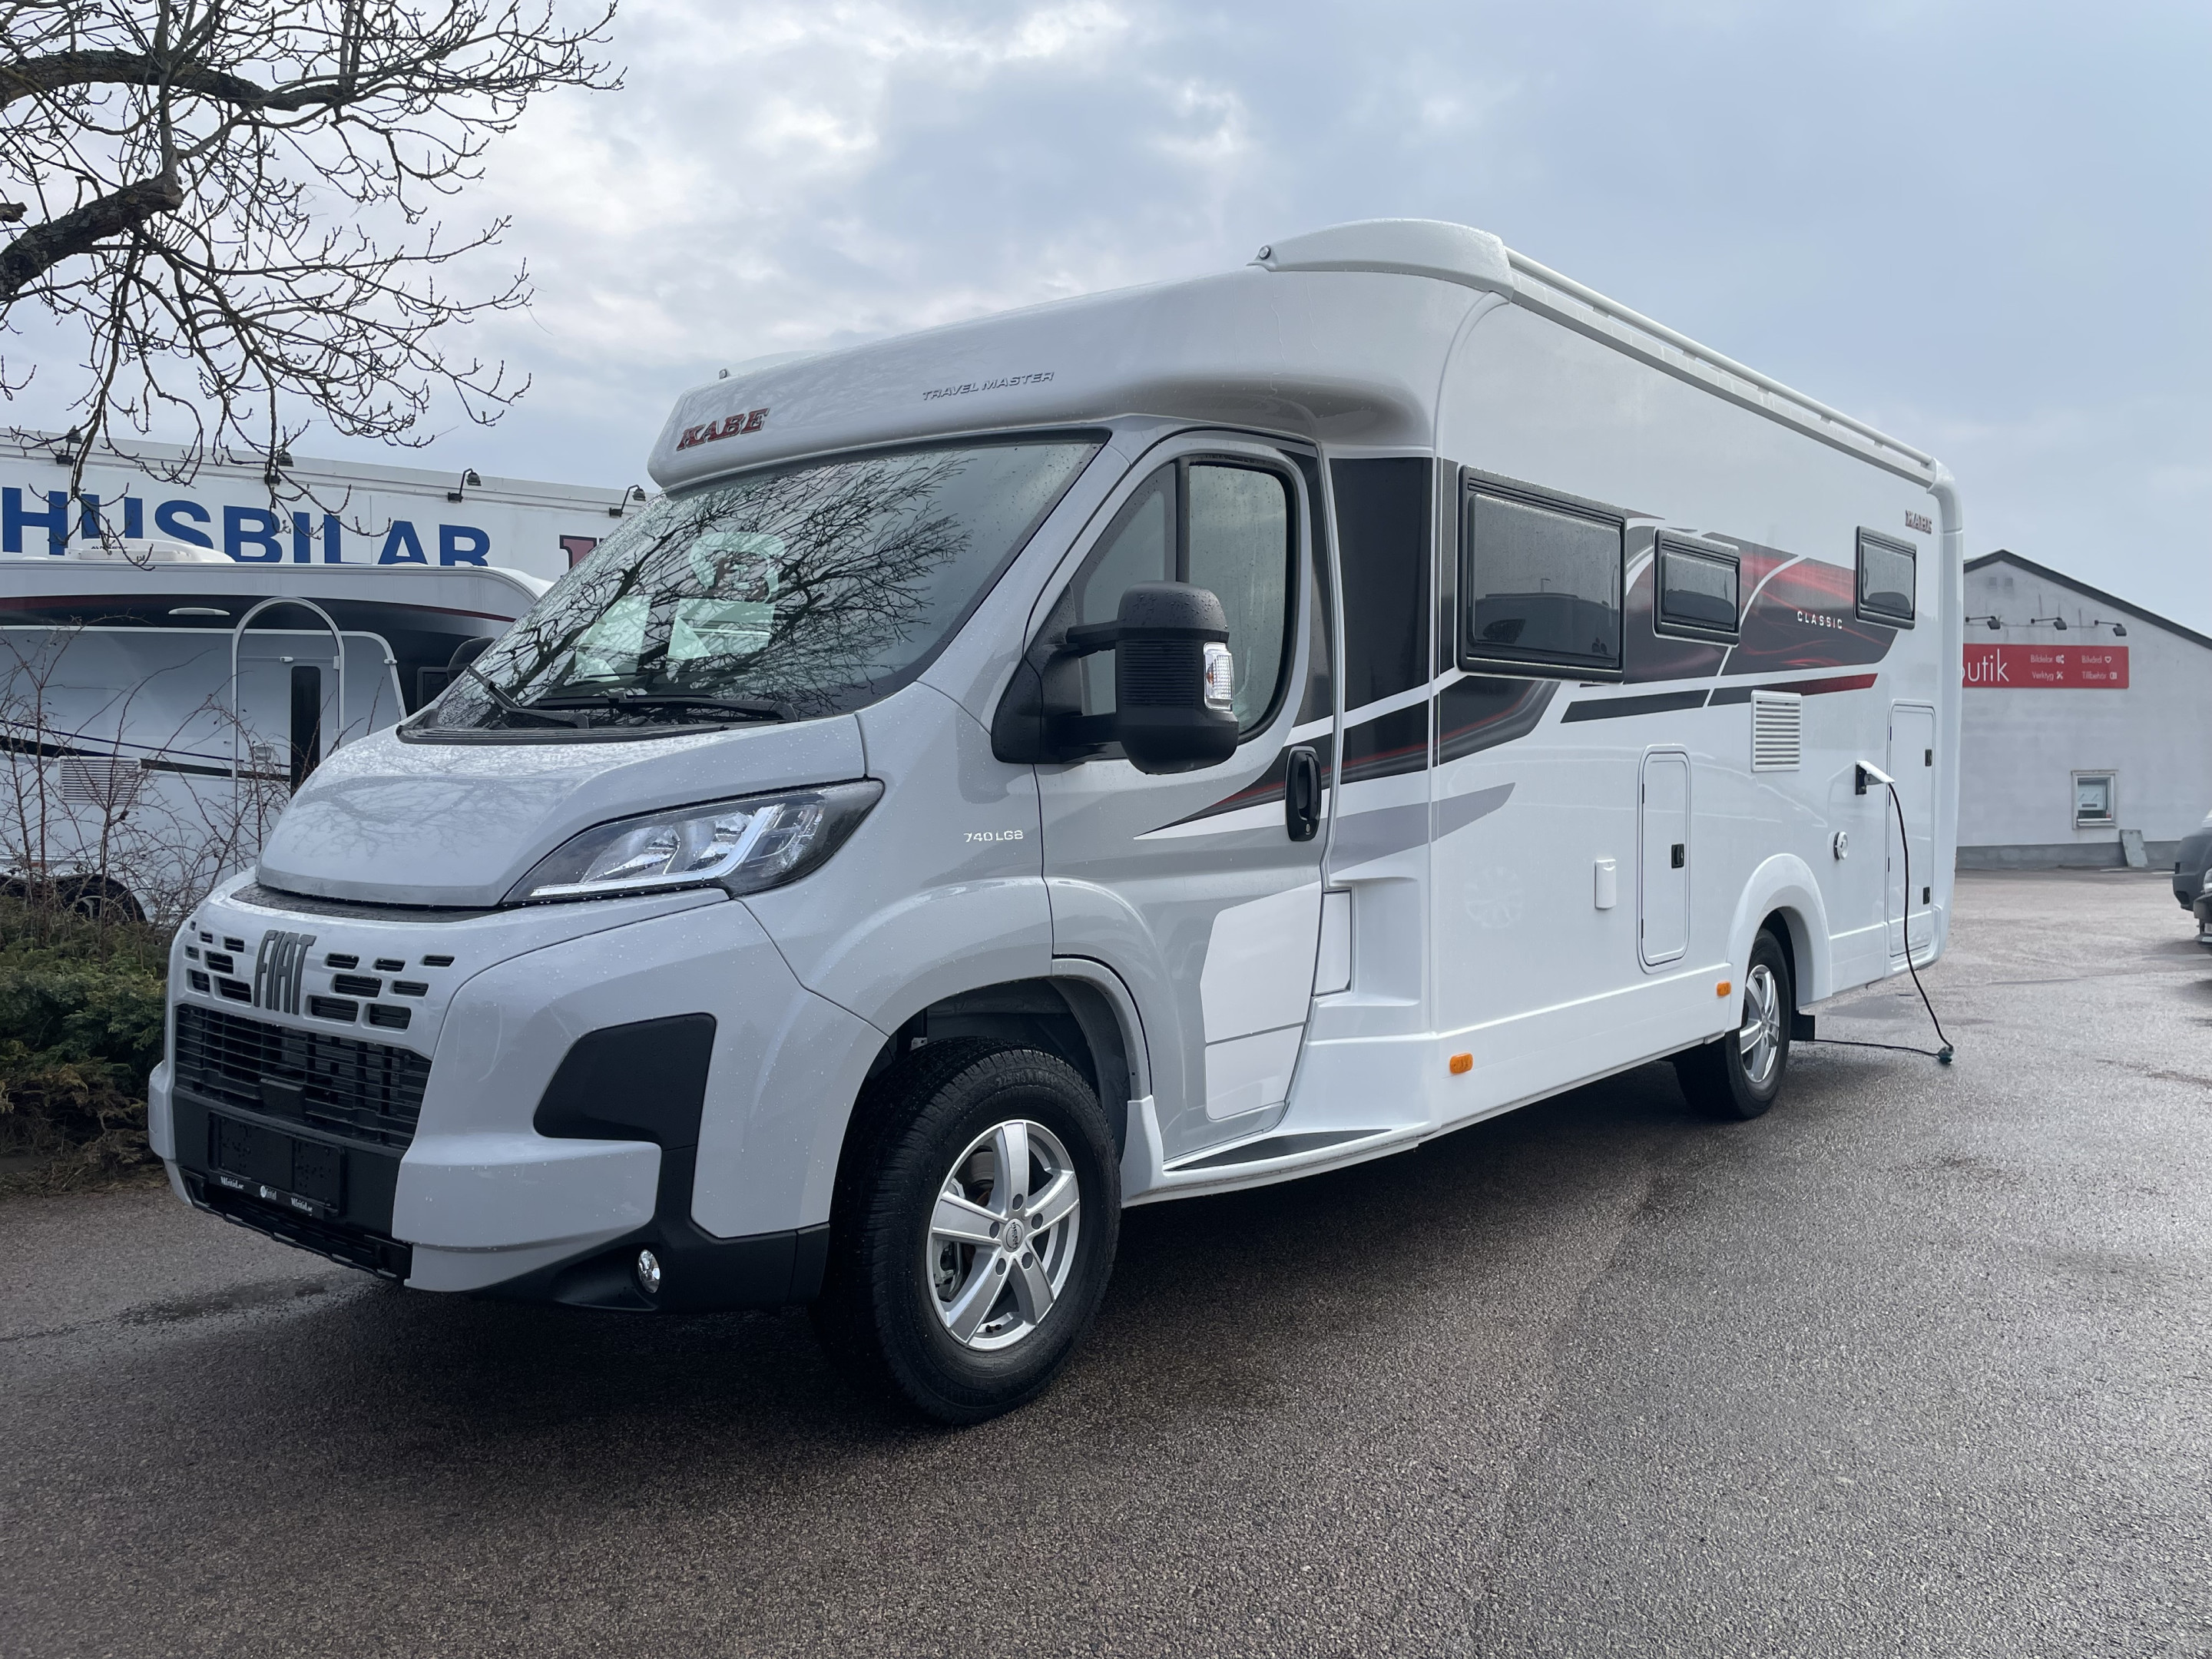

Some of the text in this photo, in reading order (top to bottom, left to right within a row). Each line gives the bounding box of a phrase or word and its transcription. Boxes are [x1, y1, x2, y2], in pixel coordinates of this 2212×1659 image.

[922, 371, 1055, 401] TRAVEL MASTER
[676, 407, 769, 451] KABE
[2, 486, 491, 568] HUSBILAR
[1905, 509, 1932, 535] KABE
[1796, 611, 1843, 629] CLASSIC
[1962, 648, 2010, 682] utik
[963, 830, 1024, 843] 740 LGB
[253, 929, 317, 1016] FIAT
